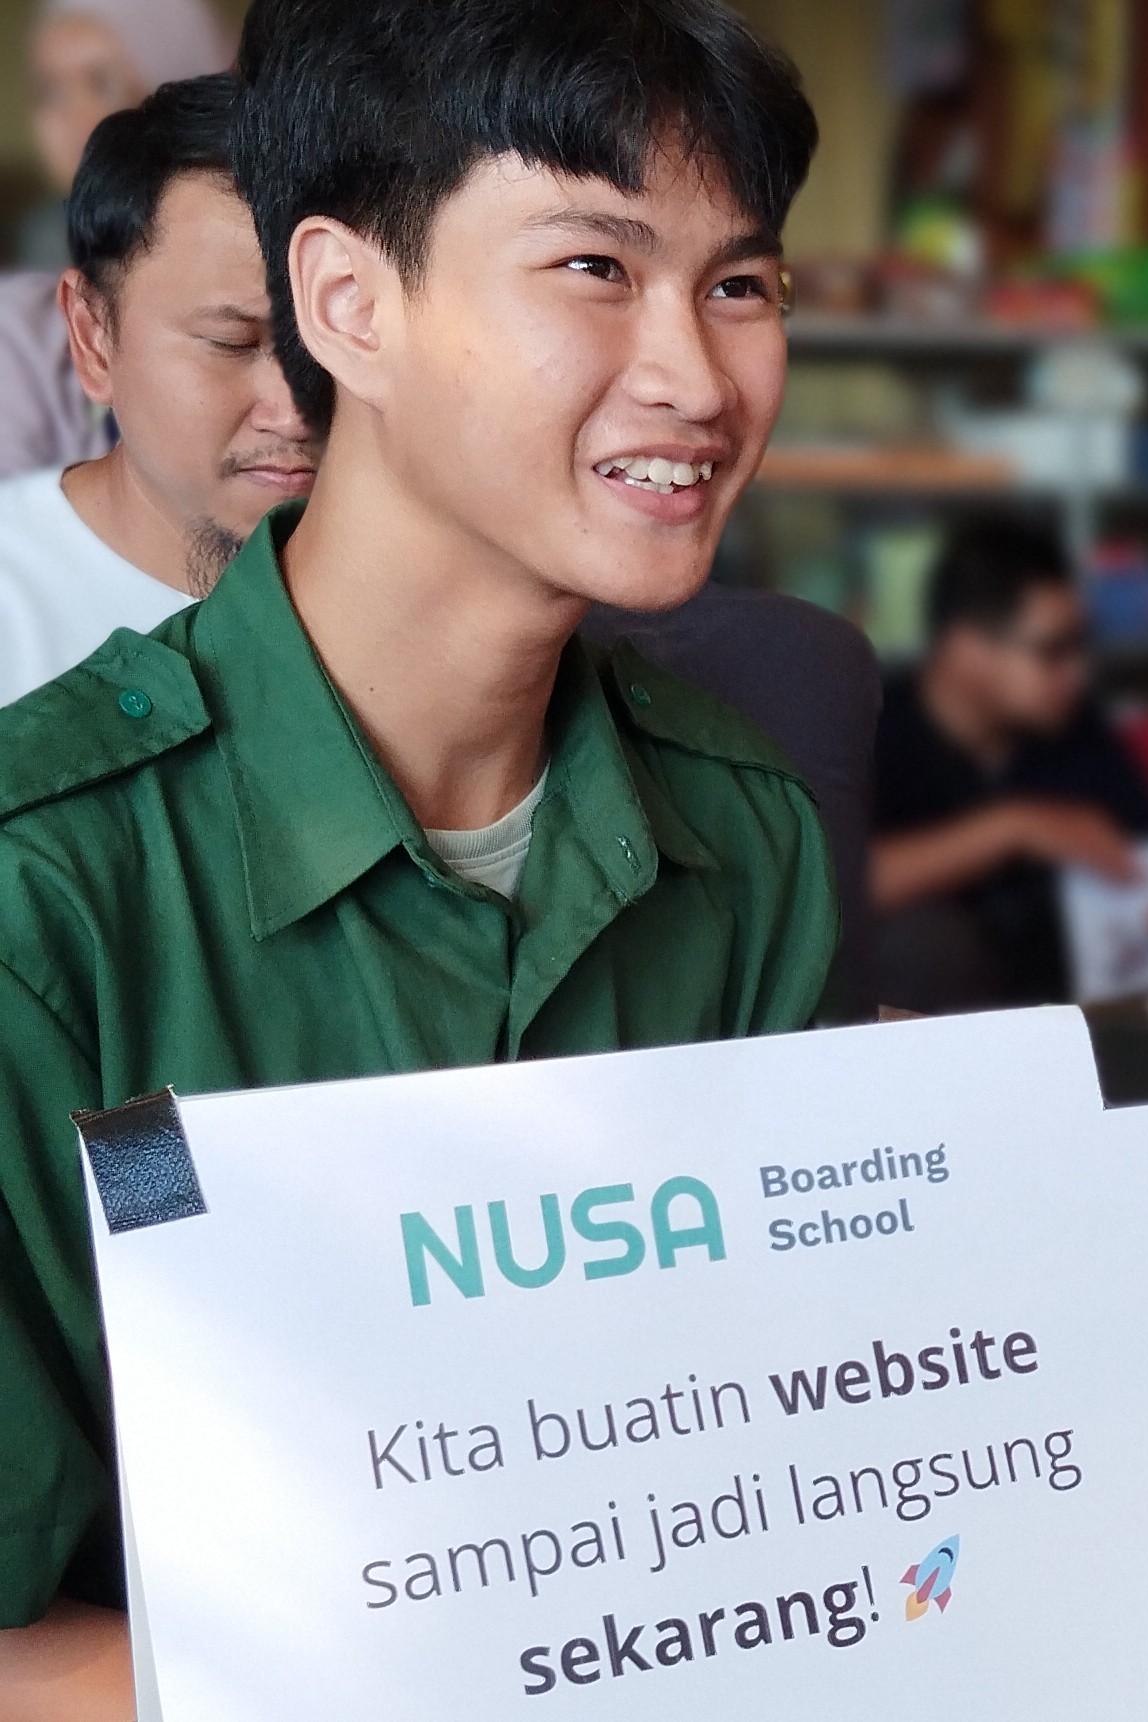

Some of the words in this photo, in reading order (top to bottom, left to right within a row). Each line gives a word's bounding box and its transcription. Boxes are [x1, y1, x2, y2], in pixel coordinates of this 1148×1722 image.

[759, 1142, 950, 1199] Boarding
[768, 1197, 915, 1252] School
[399, 1175, 727, 1307] NUSA
[367, 1419, 506, 1490] Kita
[527, 1371, 751, 1461] buatin
[767, 1327, 1039, 1416] website
[361, 1501, 626, 1609] sampai
[649, 1474, 769, 1574] jadi
[788, 1429, 1082, 1525] langsung
[519, 1565, 880, 1696] sekarang!
